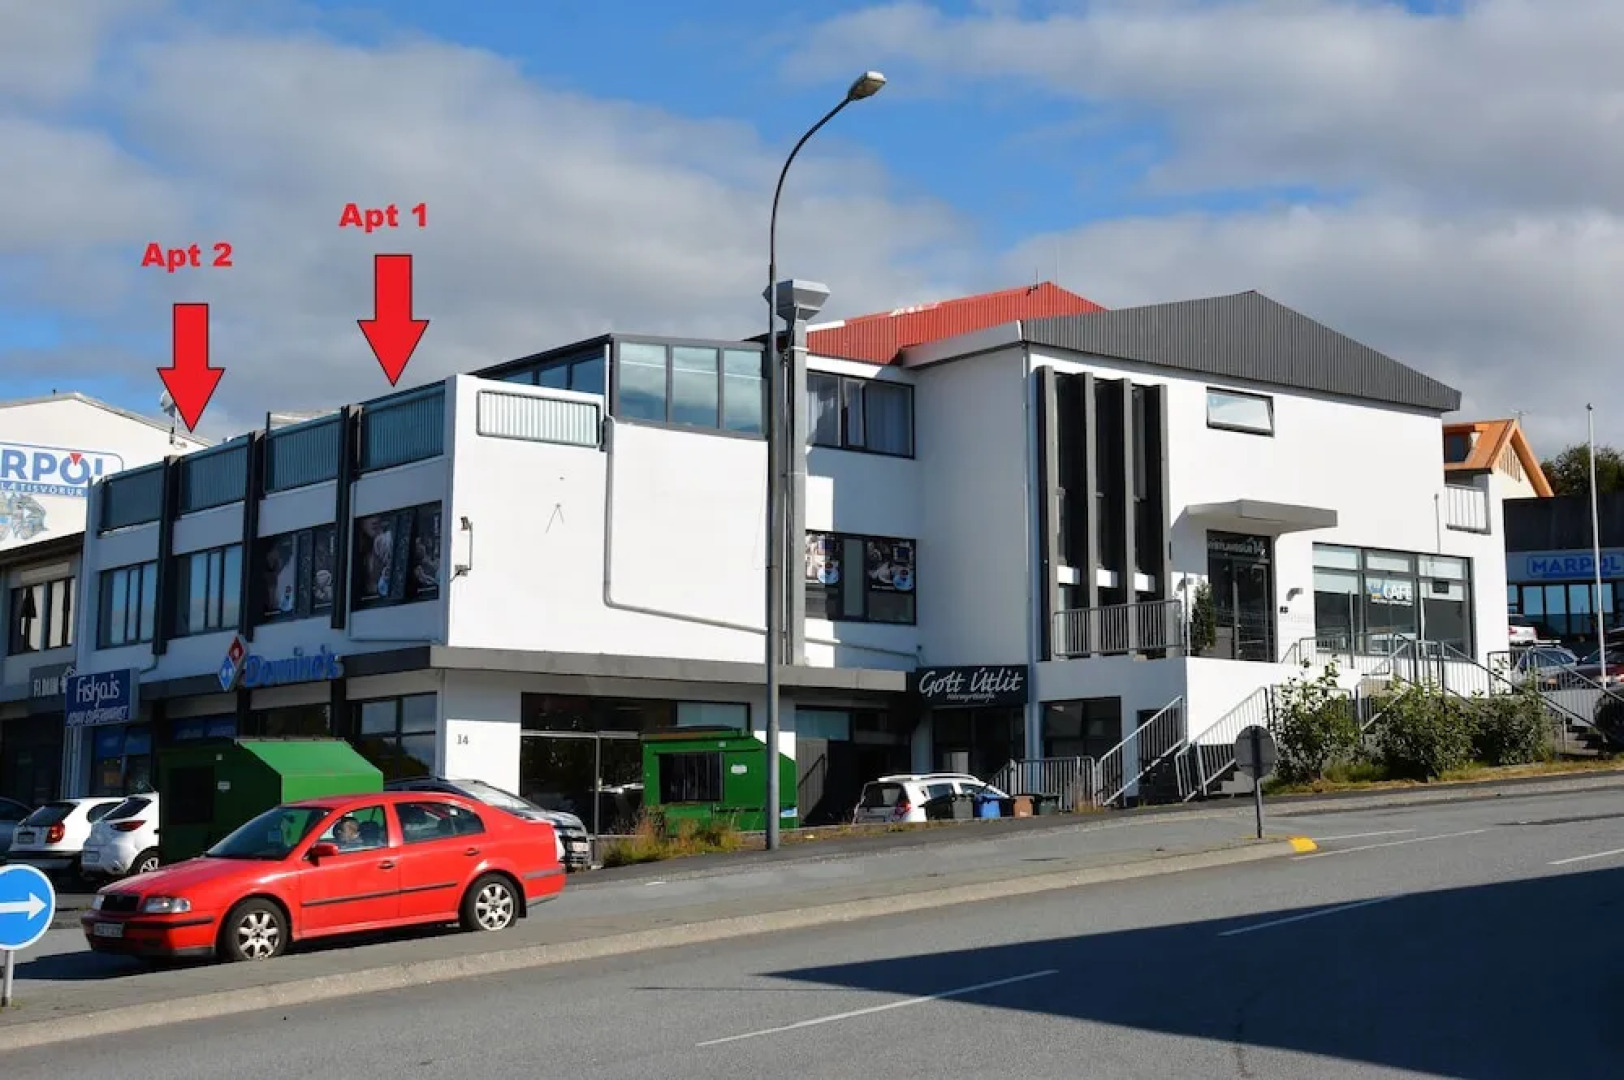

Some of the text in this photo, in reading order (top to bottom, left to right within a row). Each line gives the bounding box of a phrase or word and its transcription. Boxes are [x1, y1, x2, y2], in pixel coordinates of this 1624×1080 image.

[246, 645, 342, 687] Domino's
[919, 667, 1024, 697] Gott Útlit
[457, 733, 469, 745] 14
